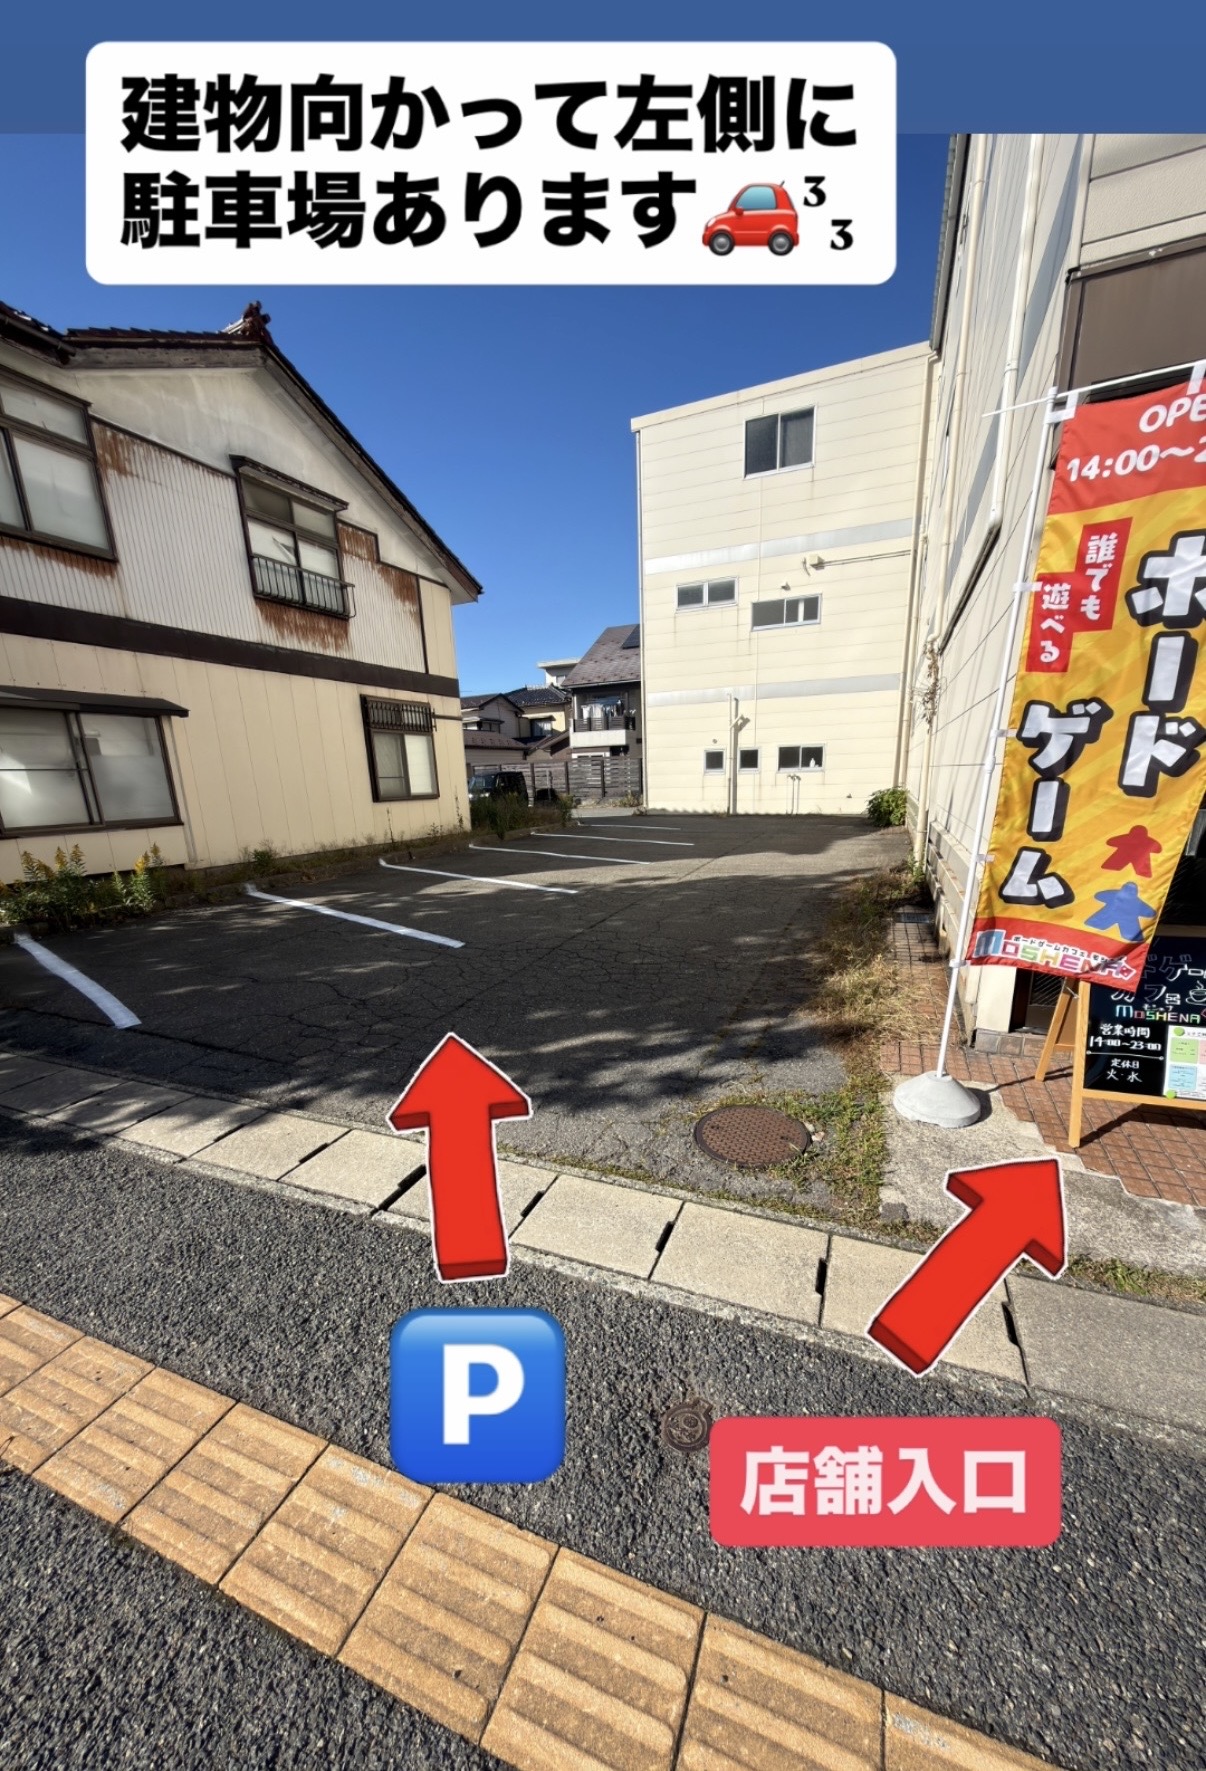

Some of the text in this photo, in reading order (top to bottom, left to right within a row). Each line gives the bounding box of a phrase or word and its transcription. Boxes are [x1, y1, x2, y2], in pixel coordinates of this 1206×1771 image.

[1080, 532, 1118, 621] 誰でも
[1040, 582, 1072, 663] 遊べる
[1001, 702, 1107, 904] ゲーム
[1100, 1023, 1151, 1038] 営業時間
[1111, 1058, 1140, 1069] 定休日
